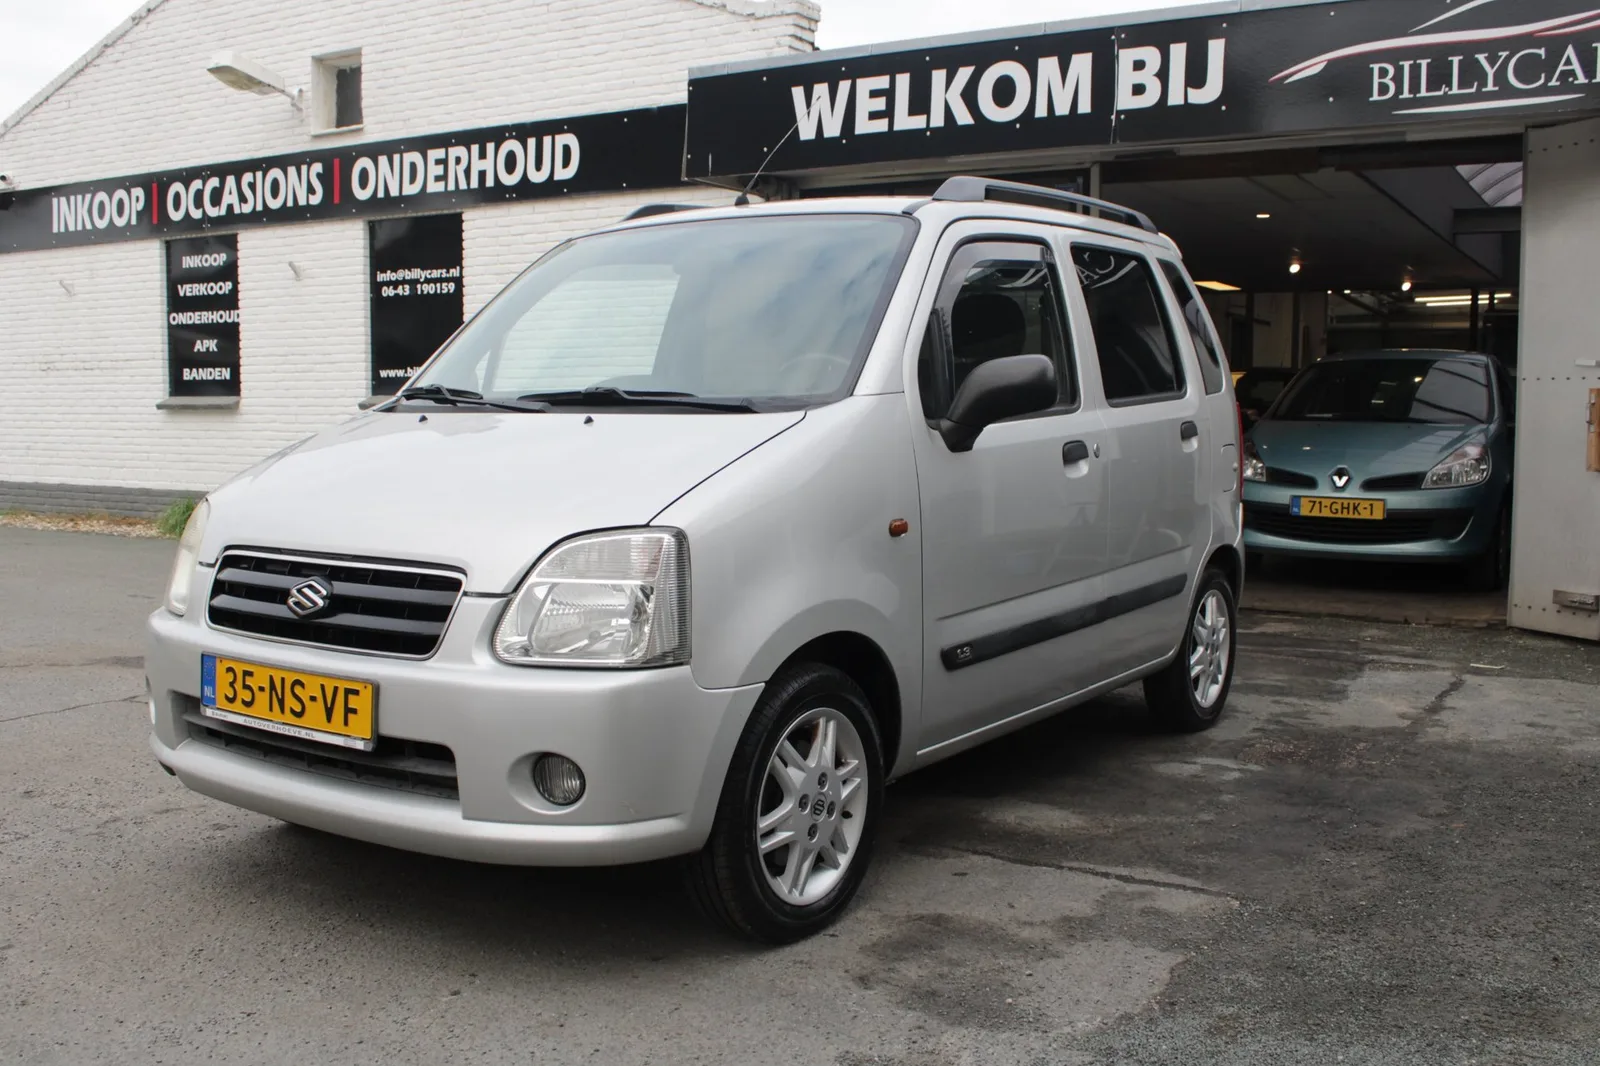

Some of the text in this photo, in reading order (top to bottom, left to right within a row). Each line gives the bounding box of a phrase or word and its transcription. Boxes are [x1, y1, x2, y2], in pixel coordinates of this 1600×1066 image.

[791, 38, 1227, 141] WELKOM BIJ
[52, 132, 580, 233] INKOOP OCCASIONS ONDERHOUD
[182, 253, 227, 268] INKOOP
[377, 266, 460, 282] info@billycars.nl
[177, 282, 232, 296] VERKOOP
[381, 282, 455, 297] 06-43 190159
[169, 310, 240, 325] ONDERHOUD
[194, 339, 218, 352] APK
[183, 367, 231, 381] BANDEN
[1308, 500, 1374, 516] 71-GHK-1
[204, 666, 360, 726] NL 35-NS-VF
